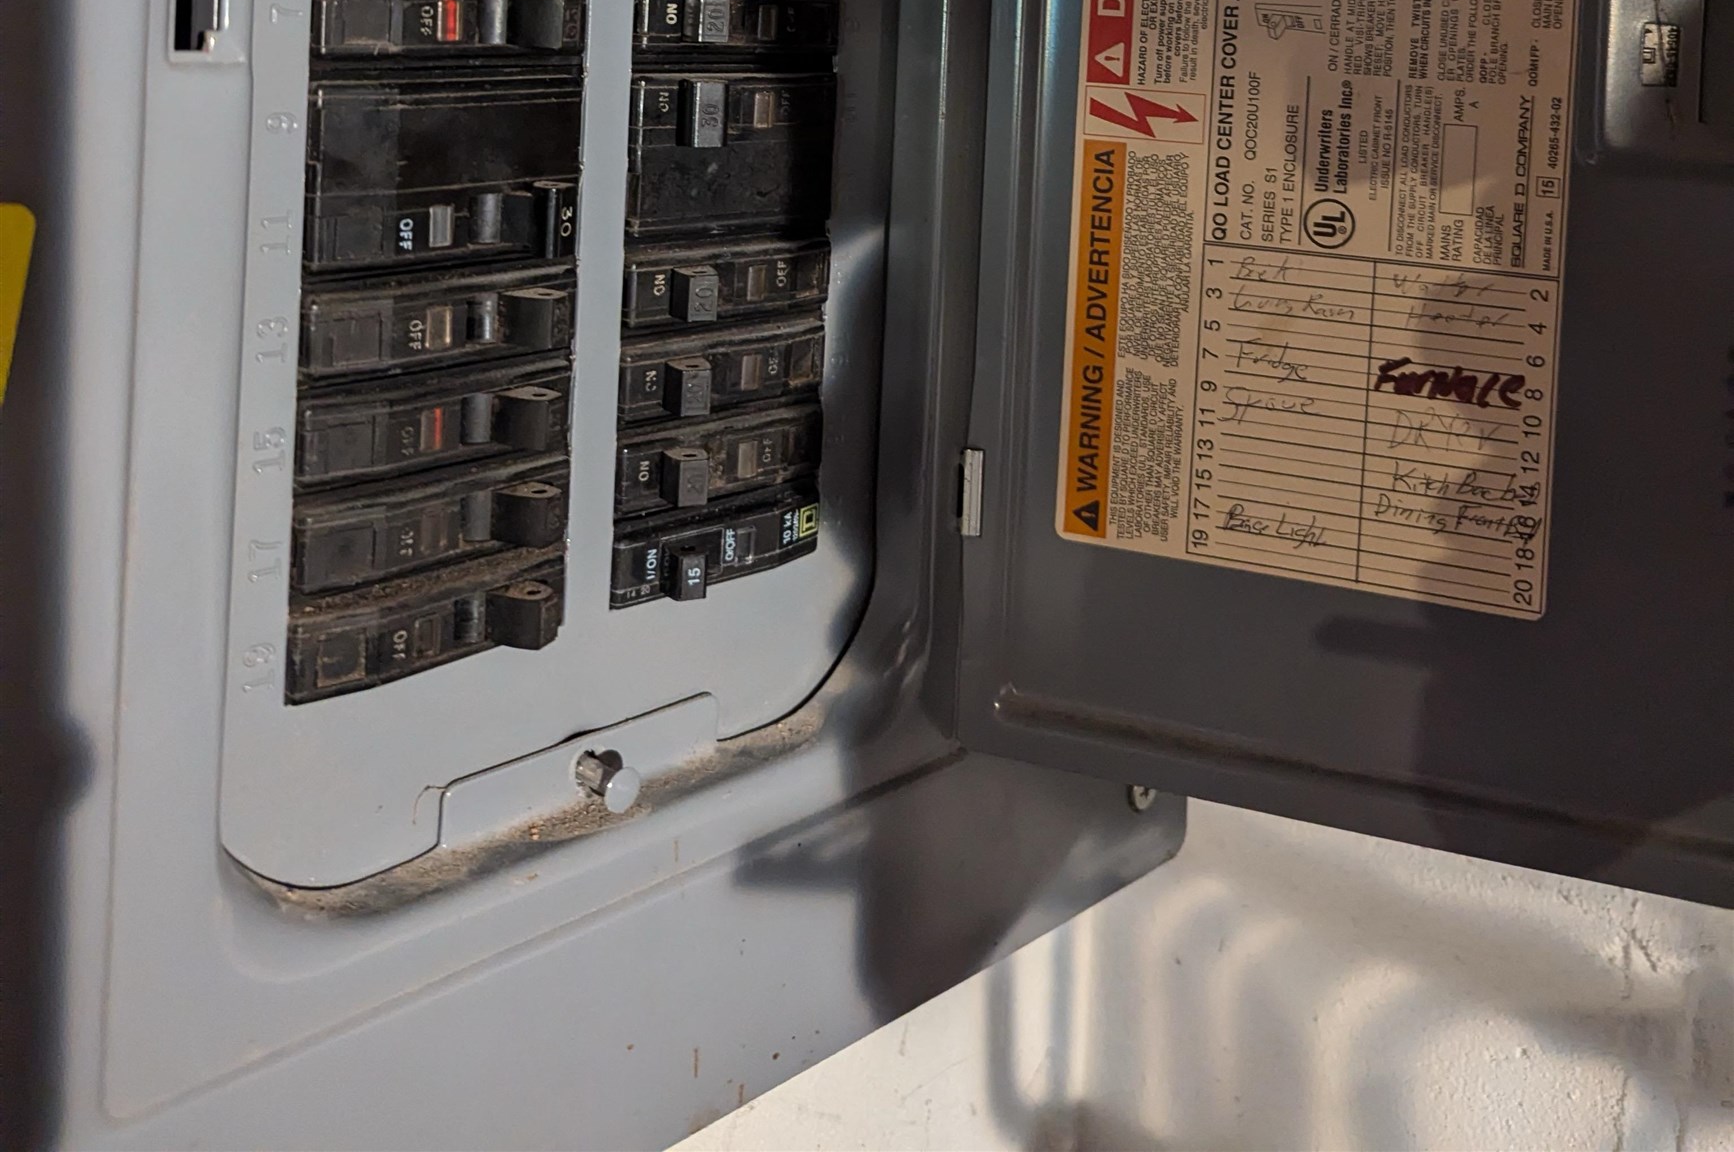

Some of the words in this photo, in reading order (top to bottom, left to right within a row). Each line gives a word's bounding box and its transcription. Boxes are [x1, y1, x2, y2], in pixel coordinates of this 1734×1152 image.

[270, 3, 303, 23] 7
[666, 3, 678, 25] ON
[707, 7, 724, 33] 20
[1139, 31, 1149, 44] OF
[1221, 6, 1239, 70] COVER
[1137, 47, 1148, 86] HAZARD
[1328, 55, 1338, 72] ON
[1408, 38, 1420, 79] REMOVE
[1216, 76, 1235, 151] CENTER
[1245, 72, 1260, 161] QOC20U100F
[1454, 88, 1465, 122] AMPS.
[266, 112, 298, 134] 9
[1515, 95, 1530, 177] COMPANY
[1548, 98, 1561, 170] 40265-432-02
[1282, 105, 1298, 192] ENCLOSURE
[1314, 110, 1332, 193] Underwriters
[1333, 113, 1351, 195] Laboratories
[1358, 131, 1368, 164] LISTED
[1213, 157, 1231, 207] LOAD
[1264, 168, 1277, 183] S1
[1541, 179, 1555, 195] 15
[1242, 181, 1254, 205] NO.
[1514, 183, 1526, 197] D
[561, 206, 573, 237] 30
[1211, 213, 1228, 241] QO
[1240, 209, 1252, 241] CAT.
[1261, 192, 1276, 242] SERIES
[1280, 208, 1294, 244] TYPE
[1312, 211, 1346, 238] UL
[1544, 211, 1553, 235] U.S.A.
[260, 210, 293, 256] 11
[400, 219, 412, 251] OFF
[1084, 149, 1114, 342] ADVERTENCIA
[1440, 226, 1451, 261] MAINS
[1452, 220, 1464, 262] RATING
[1472, 207, 1484, 264] CAPACIDAD
[1492, 214, 1504, 266] PRINCIPAL
[1511, 203, 1525, 268] SQUARE
[1544, 237, 1552, 246] IN
[1206, 259, 1223, 267] 1
[1542, 248, 1551, 272] MADE
[654, 274, 665, 296] ON
[776, 260, 787, 287] OFF
[1205, 288, 1222, 300] 3
[1528, 290, 1547, 302] 2
[1203, 320, 1220, 332] 5
[1526, 322, 1546, 335] 4
[255, 316, 289, 364] 13
[1083, 347, 1104, 359] /
[1201, 348, 1218, 360] 7
[1524, 356, 1544, 368] 6
[1200, 381, 1217, 393] 9
[1523, 389, 1542, 402] 8
[1076, 365, 1103, 493] WARNING
[1198, 408, 1215, 428] 11
[1521, 415, 1541, 439] 10
[252, 426, 286, 475] 15
[1196, 439, 1214, 461] 13
[1519, 451, 1539, 475] 12
[639, 460, 650, 482] ON
[1194, 469, 1212, 491] 15
[1193, 498, 1211, 521] 17
[1191, 530, 1209, 549] 19
[247, 538, 283, 583] 17
[1514, 548, 1535, 572] 18
[688, 568, 701, 585] 15
[1513, 580, 1533, 607] 20
[241, 642, 277, 694] 19
